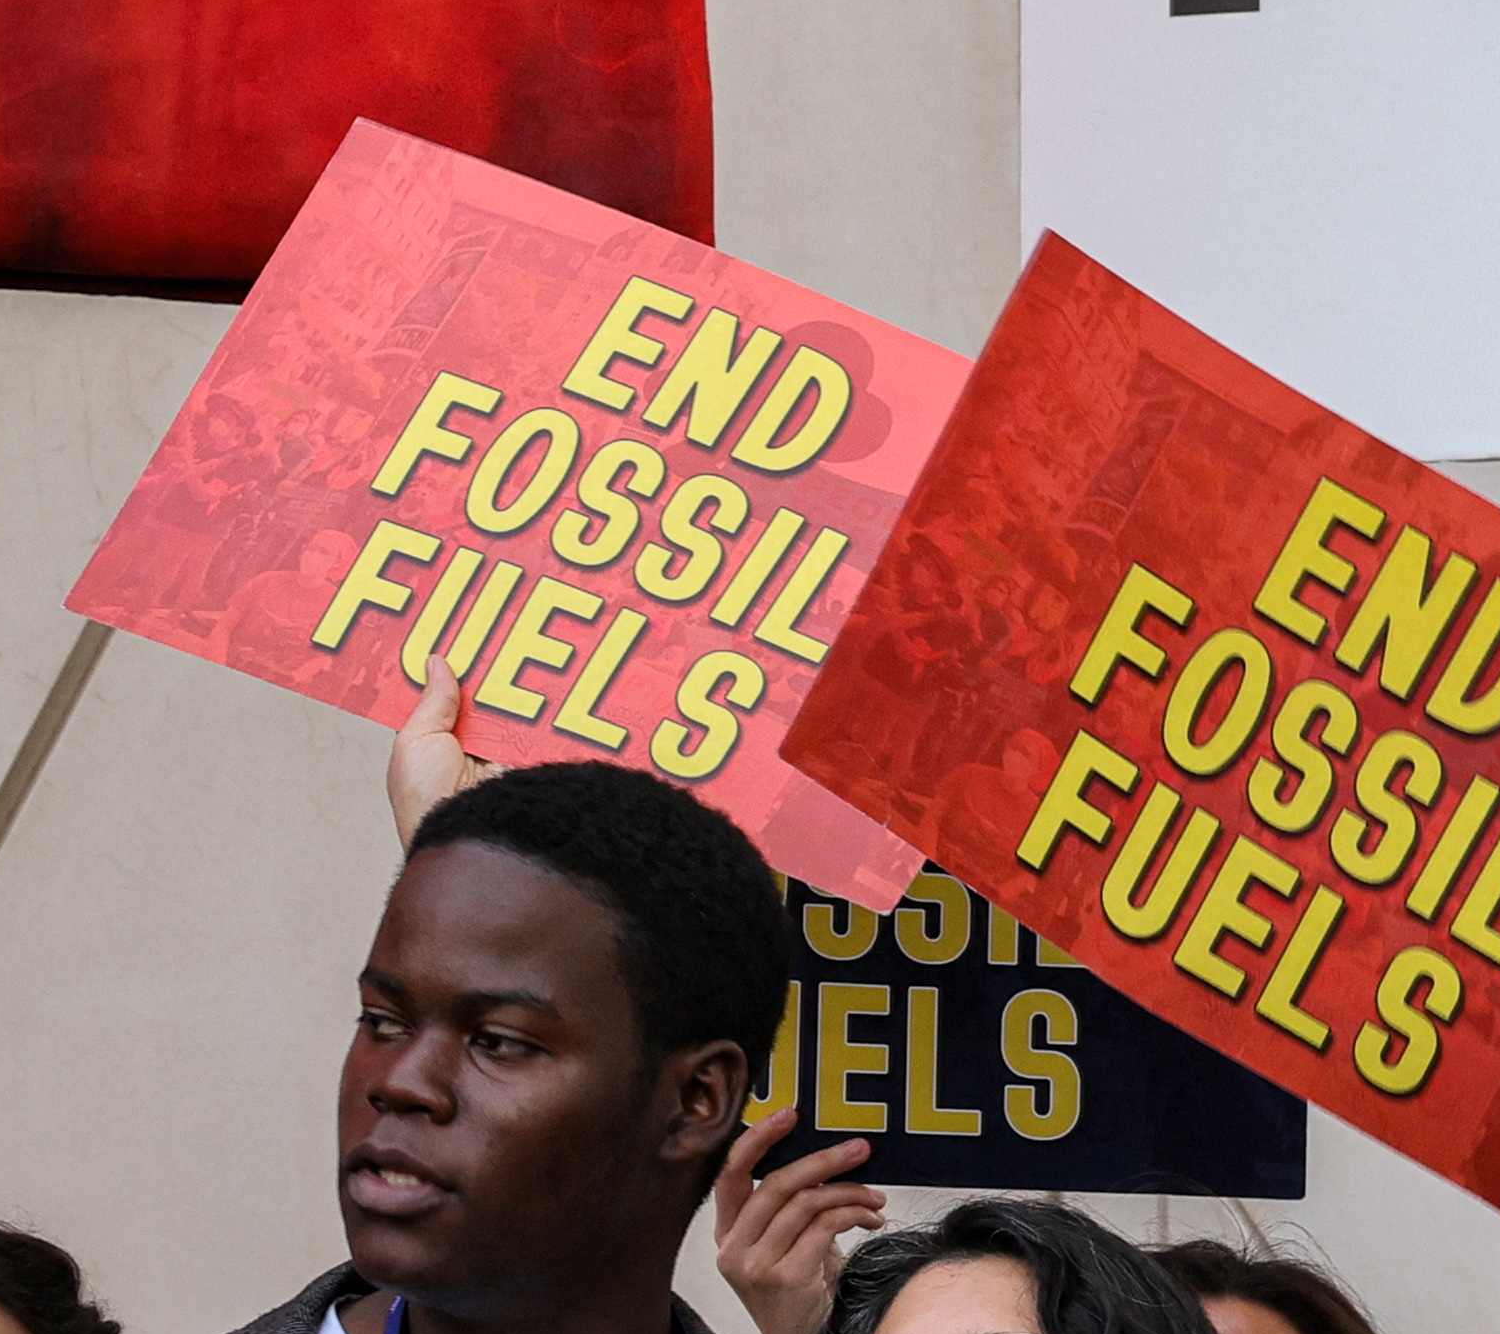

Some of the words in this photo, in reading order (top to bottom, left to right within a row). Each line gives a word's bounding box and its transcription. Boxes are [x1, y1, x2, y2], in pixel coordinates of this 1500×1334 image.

[562, 274, 851, 472] END
[311, 519, 766, 780] FUELS
[370, 369, 849, 663] FOSSIL
[1016, 729, 1462, 1096] FUELS
